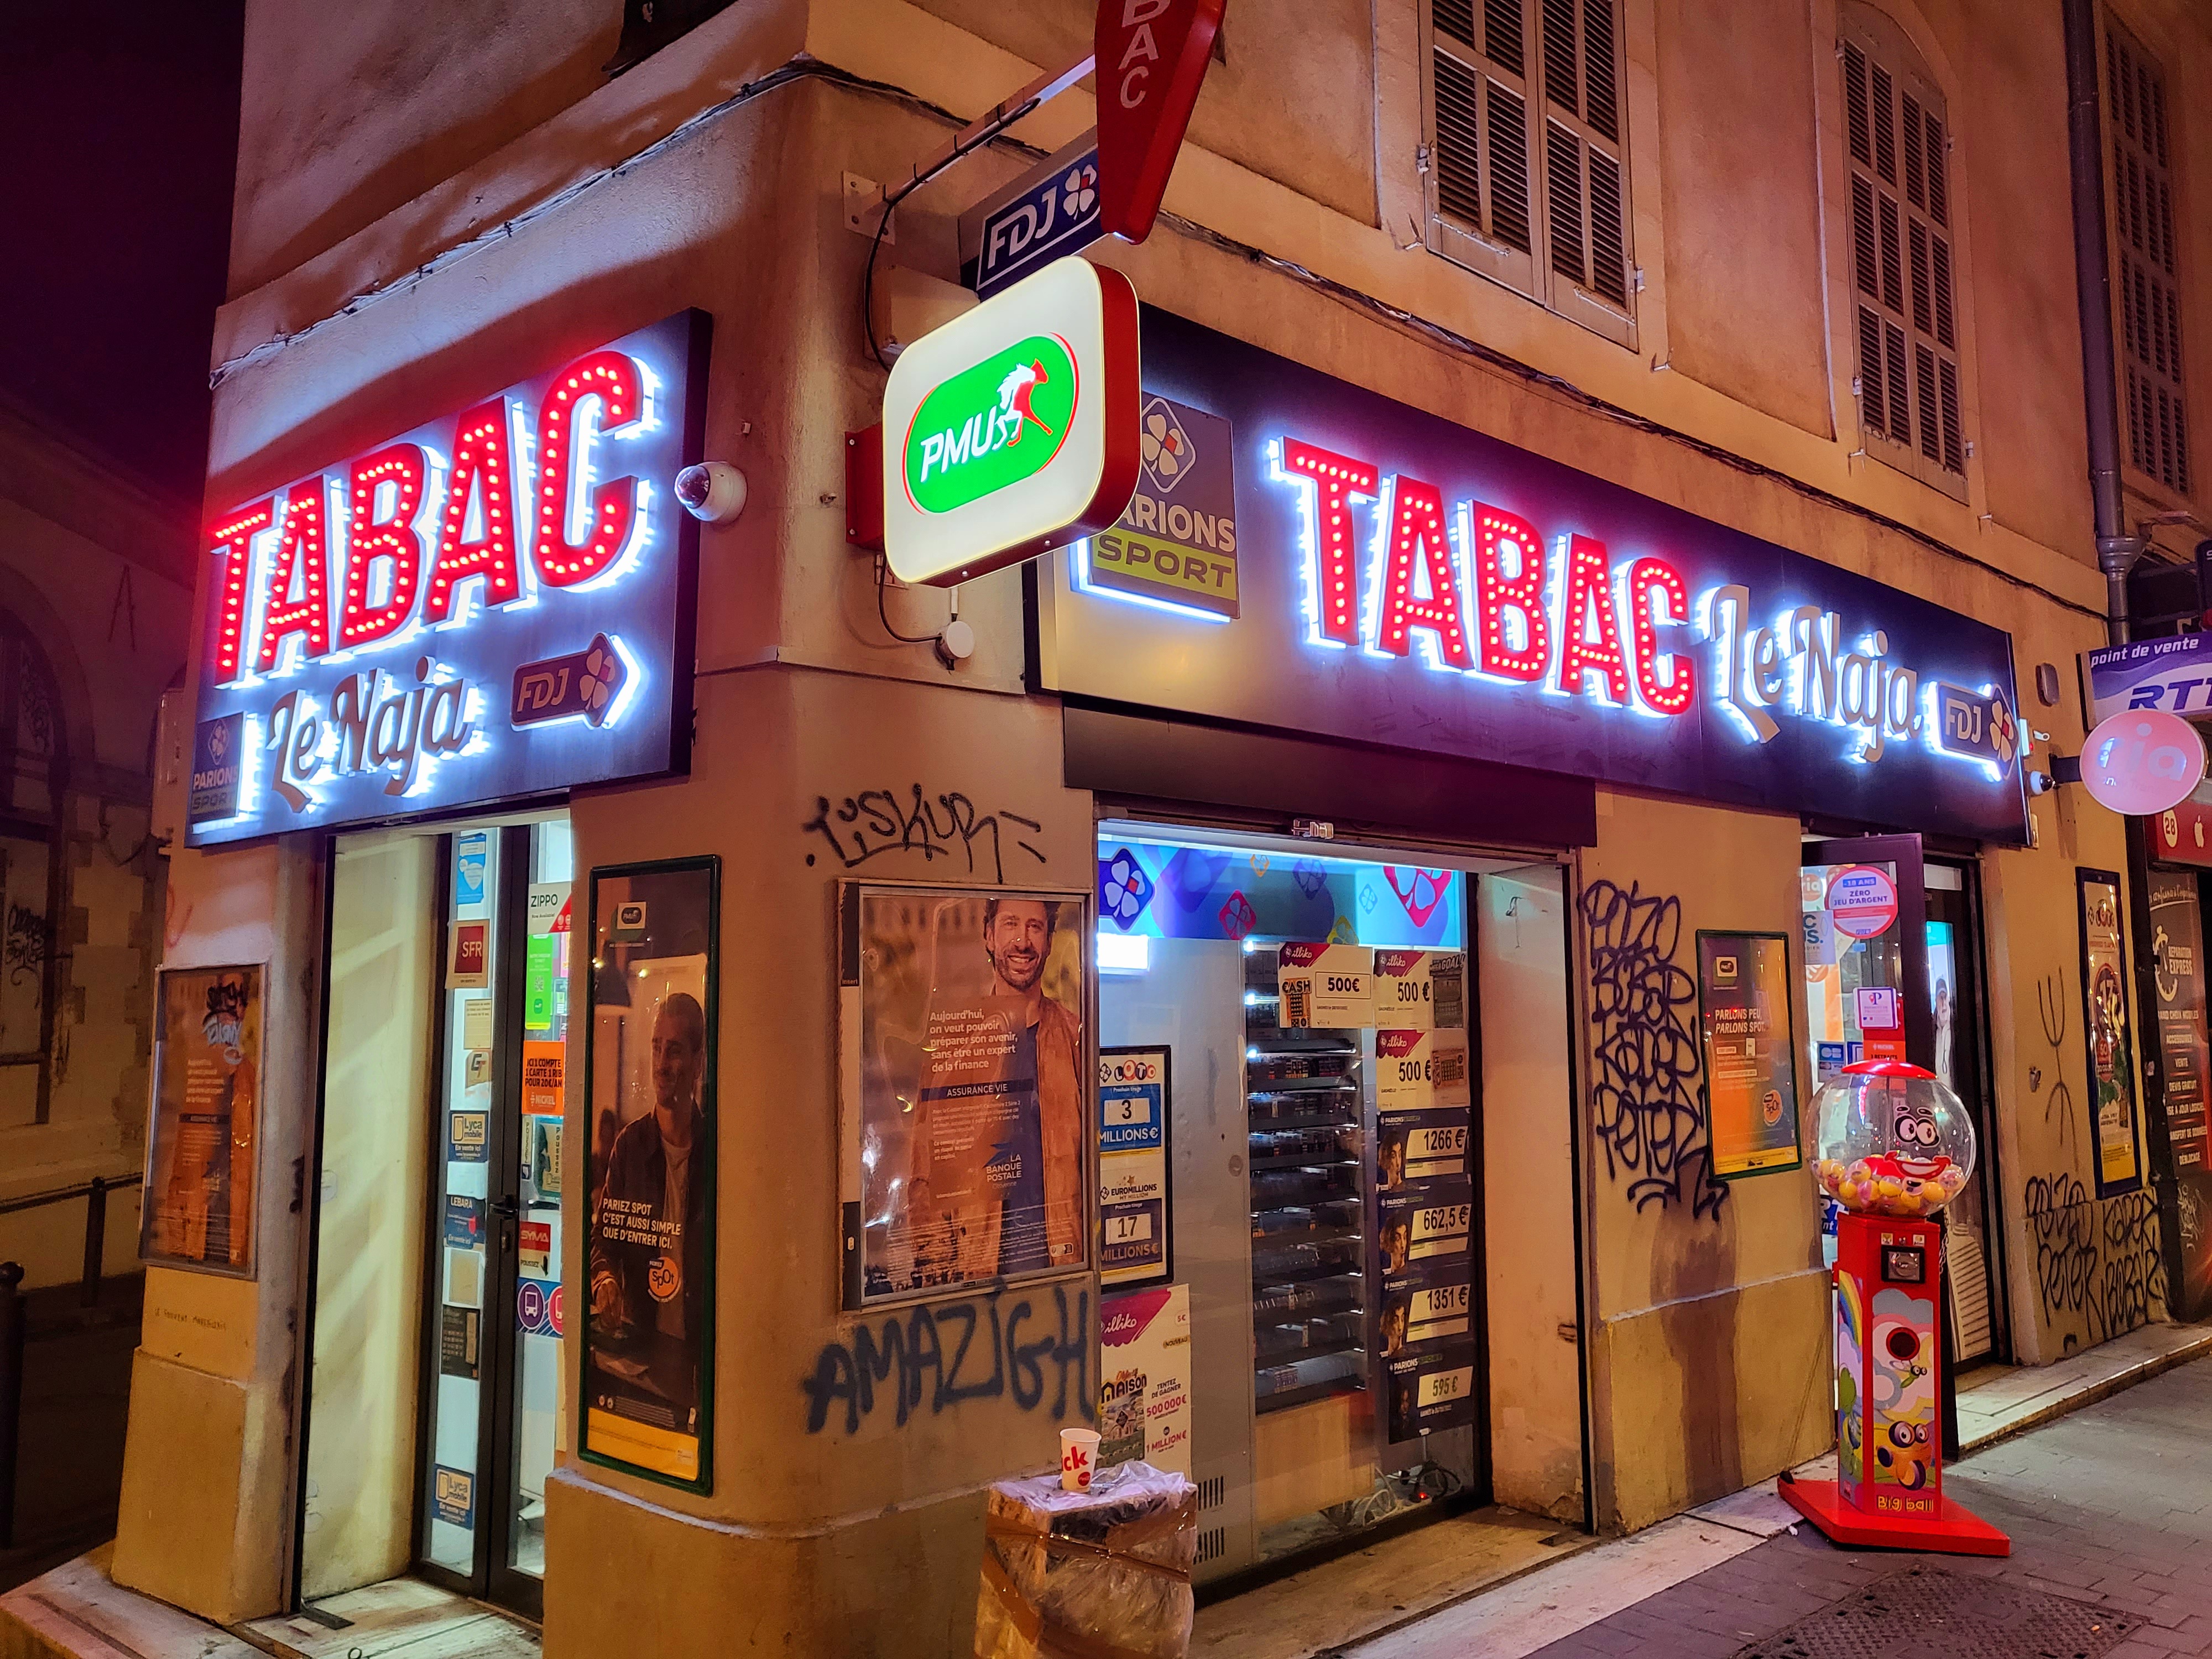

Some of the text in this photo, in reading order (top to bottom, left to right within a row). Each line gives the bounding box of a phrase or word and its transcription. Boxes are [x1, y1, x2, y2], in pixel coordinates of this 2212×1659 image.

[988, 185, 1058, 270] FDJ
[920, 419, 995, 483] PMU
[208, 351, 653, 687] TABAC
[1097, 535, 1233, 590] SPORT
[1277, 436, 1695, 716] TABAC
[2091, 637, 2199, 667] point de vente
[1710, 585, 1922, 763] Le Naja
[517, 667, 570, 713] FDJ
[1945, 699, 1983, 745] FDJ
[268, 656, 471, 812] Le Naja
[2164, 817, 2176, 836] 28
[531, 894, 558, 907] ZIPPO
[1849, 896, 1888, 905] D'ARGENT
[462, 941, 482, 958] SFR
[1292, 946, 1312, 958] illiko
[1387, 954, 1406, 967] illiko
[2169, 959, 2193, 975] EXPRESS
[1328, 977, 1360, 993] 500€
[1398, 982, 1430, 1002] 500 €
[930, 1008, 984, 1022] Aujourd'hui,
[1715, 1008, 1747, 1021] PARLONS
[944, 1025, 964, 1033] veut
[966, 1021, 999, 1034] pouvoir
[1715, 1021, 1766, 1035] PARLONS SPOT.
[930, 1036, 969, 1048] préparer
[988, 1032, 1018, 1042] avenir,
[1386, 1035, 1407, 1047] illiko
[953, 1048, 972, 1058] être
[987, 1045, 1016, 1055] expert
[539, 1058, 561, 1068] COMPTE
[932, 1060, 989, 1072] de la finance
[1114, 1059, 1156, 1082] LOTO
[1399, 1061, 1421, 1082] 500
[1425, 1060, 1431, 1081] €
[529, 1068, 547, 1077] CARTE
[525, 1078, 540, 1087] POUR
[947, 1083, 1008, 1097] ASSURANCE VIE
[535, 1095, 555, 1105] NICKEL
[1121, 1099, 1132, 1120] 3
[465, 1118, 482, 1130] Lyca
[464, 1130, 482, 1138] mobile
[1423, 1128, 1466, 1151] 1266 €
[986, 1162, 1022, 1174] BANQUE
[987, 1170, 1022, 1182] POSTALE
[1111, 1183, 1157, 1197] EUROMILLIONS
[451, 1196, 472, 1209] LEBARA
[603, 1198, 652, 1216] PARIEZ SPOT
[602, 1212, 681, 1235] C'EST AUSSI SIMPLE
[1118, 1216, 1138, 1238] 17
[1423, 1206, 1469, 1232] 662,5 €
[603, 1227, 673, 1249] QUE D'ENTRER ICI.
[1427, 1286, 1468, 1311] 1351 €
[1105, 1313, 1137, 1333] illiko
[1165, 1337, 1188, 1348] NOUVEAU
[802, 1285, 1094, 1434] AMAZIGH
[1394, 1358, 1418, 1371] PARIONS
[1157, 1378, 1176, 1391] TENTEZ
[1159, 1384, 1181, 1397] GAGNER
[1433, 1376, 1458, 1397] 595 €
[449, 1476, 468, 1493] Lyca
[1877, 1494, 1933, 1514] Big ball
